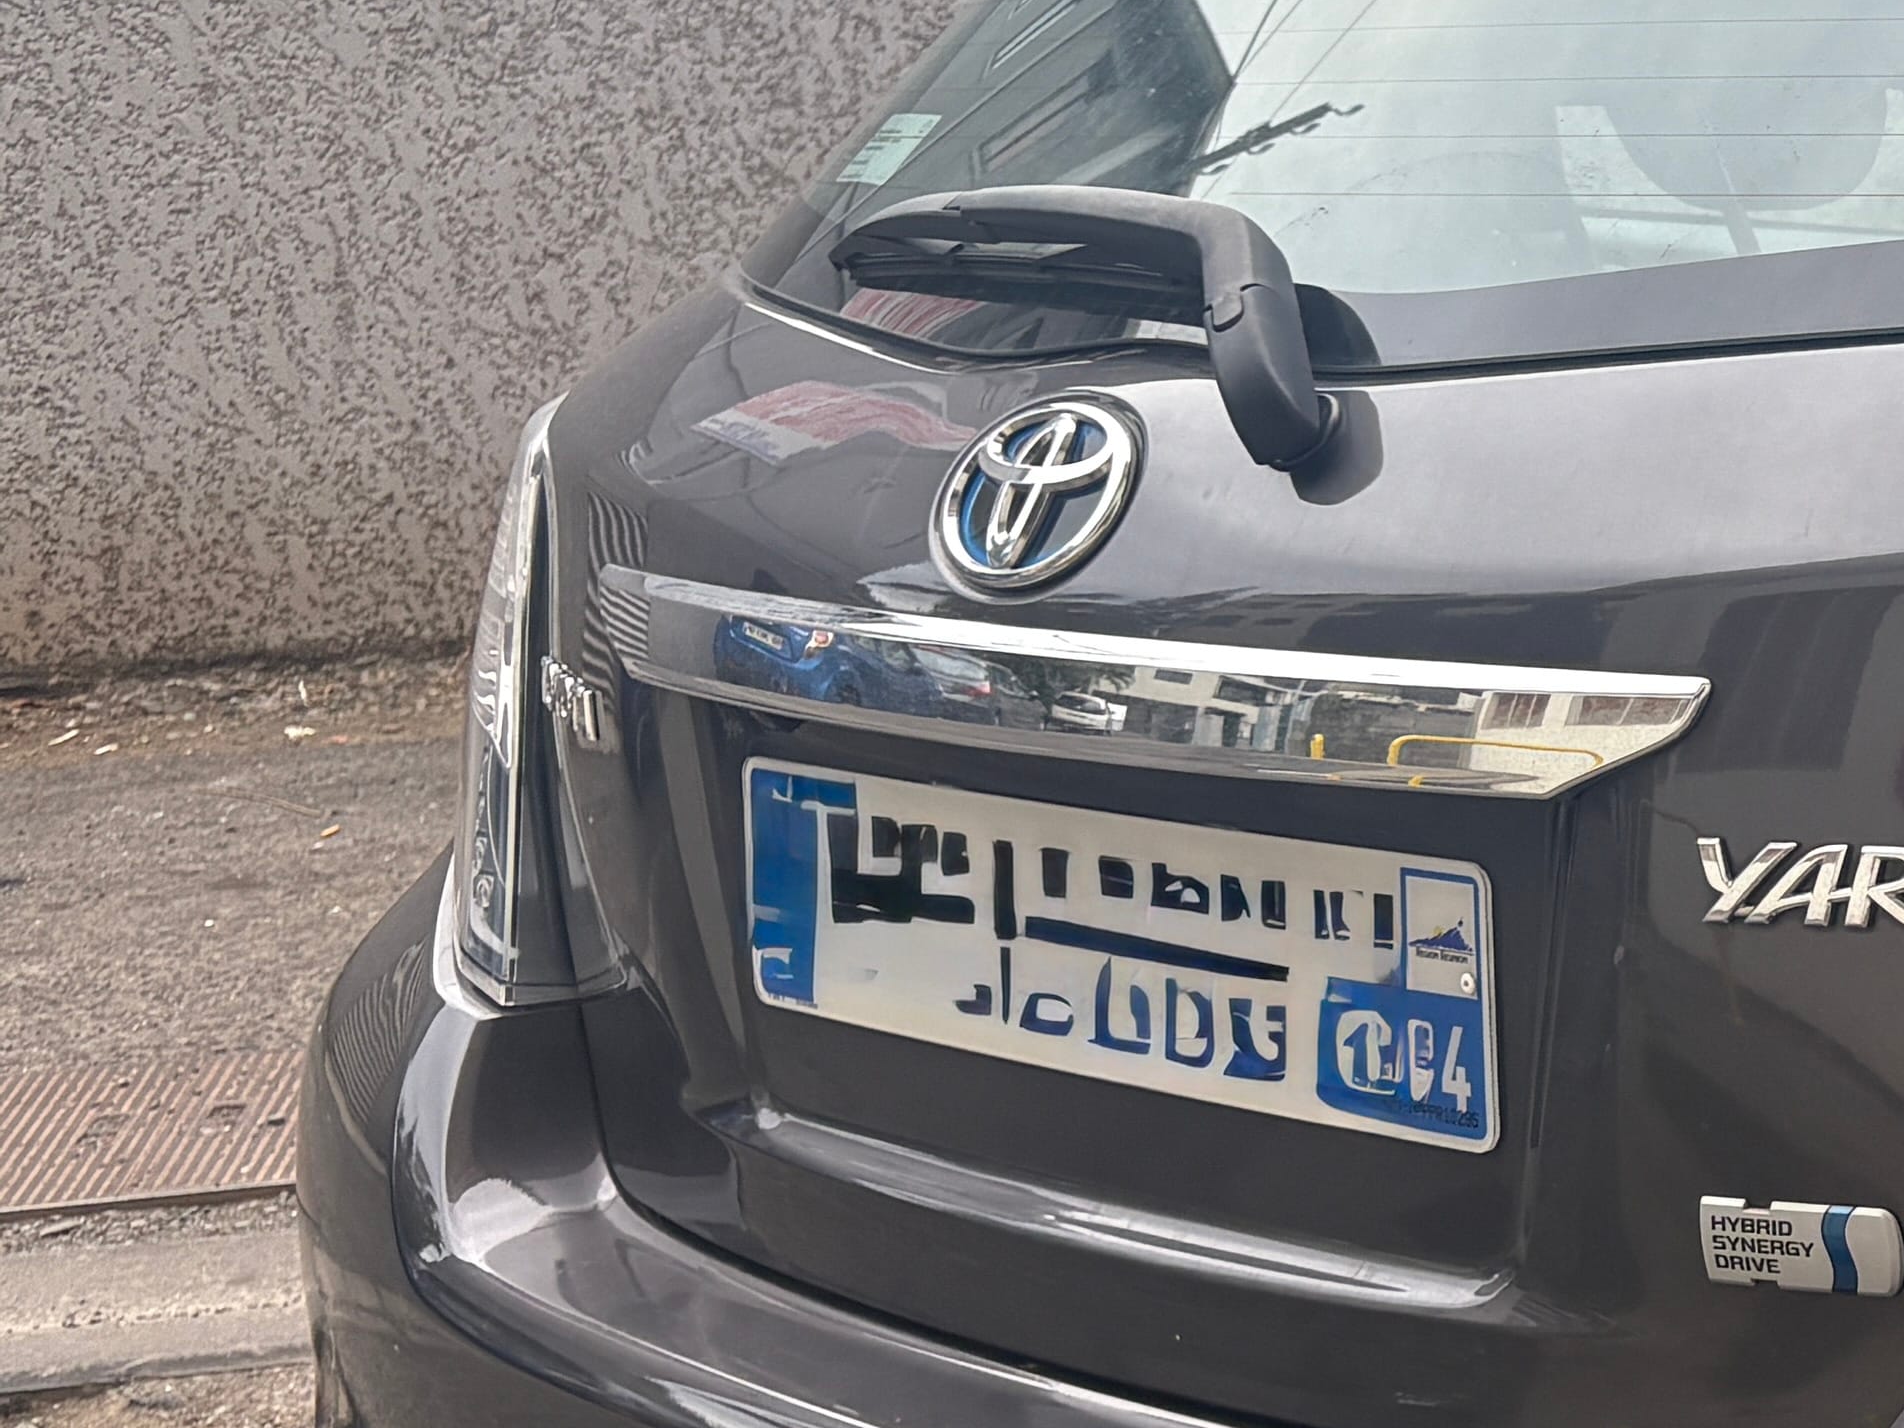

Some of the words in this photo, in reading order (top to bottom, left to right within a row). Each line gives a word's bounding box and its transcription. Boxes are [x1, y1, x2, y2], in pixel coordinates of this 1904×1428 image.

[1710, 1214, 1793, 1238] HYBRID
[1712, 1234, 1814, 1258] SYNERGY
[1715, 1254, 1781, 1275] DRIVE
